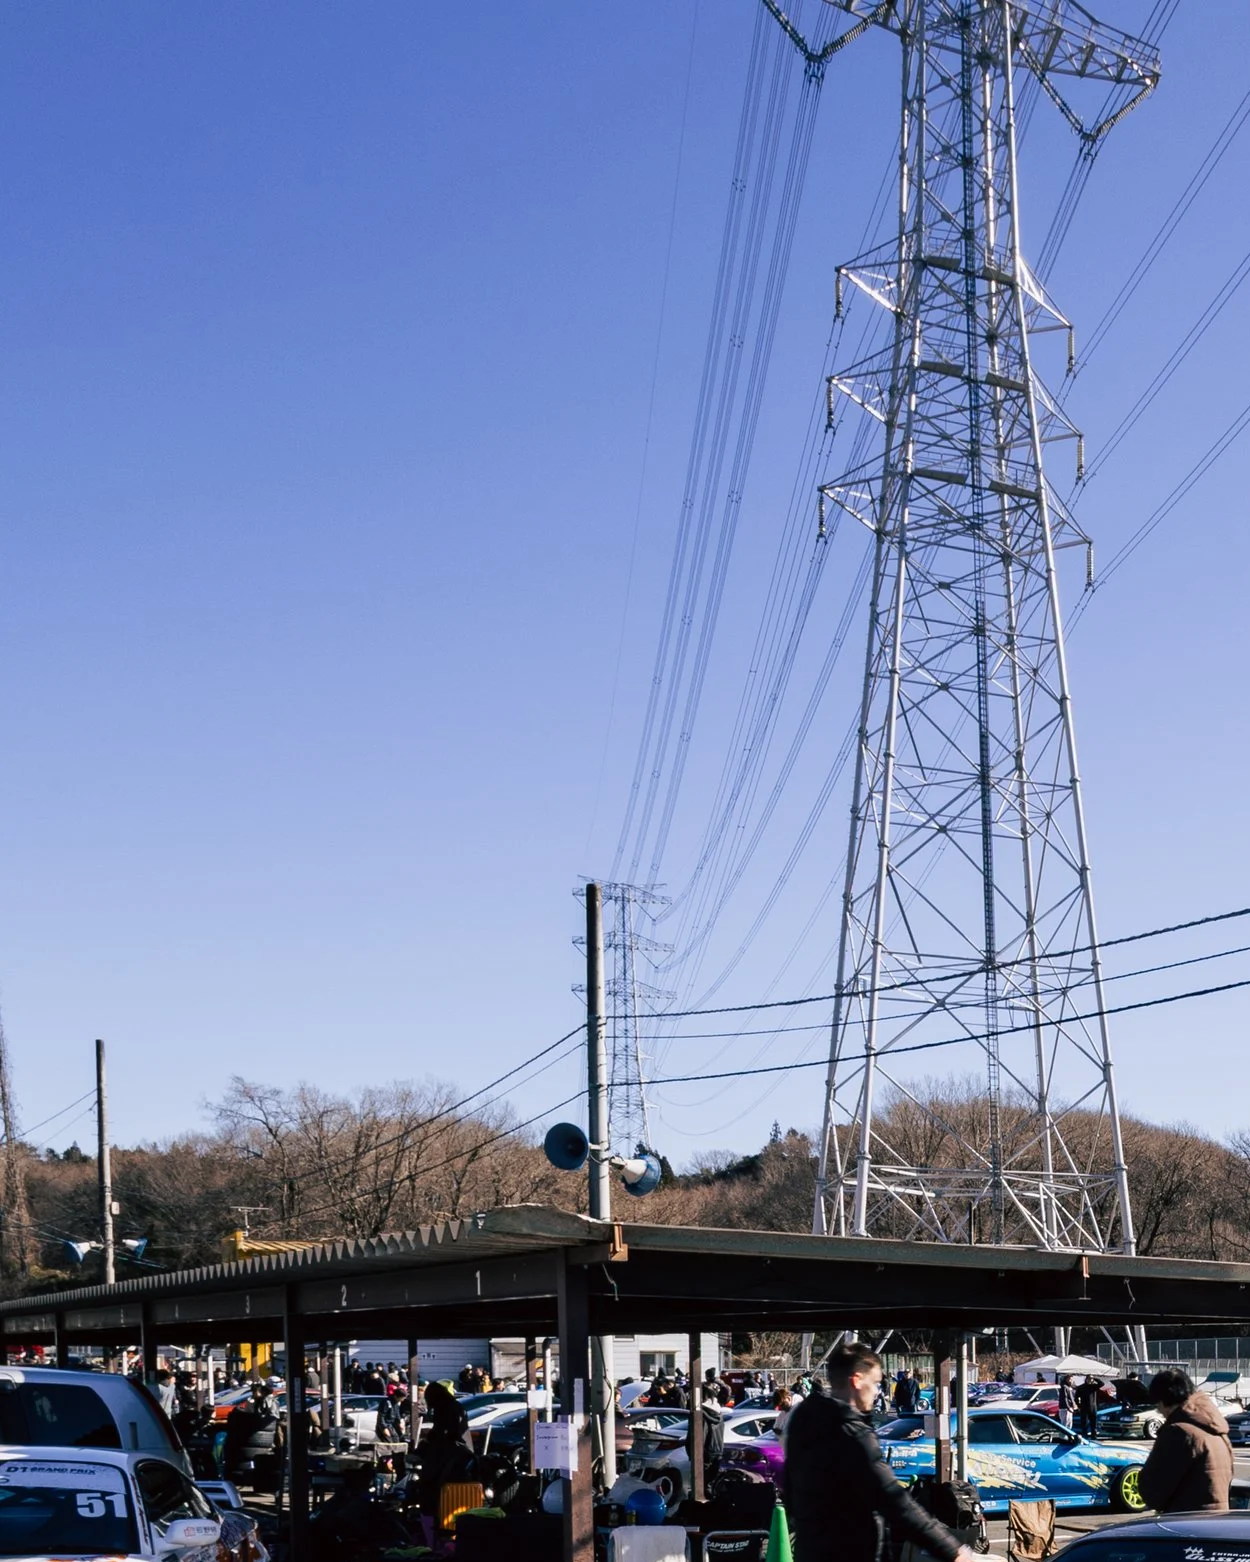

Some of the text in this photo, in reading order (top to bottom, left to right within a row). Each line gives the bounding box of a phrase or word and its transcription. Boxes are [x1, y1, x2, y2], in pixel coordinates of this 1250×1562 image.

[475, 1270, 482, 1296] 1
[341, 1284, 348, 1307] 2
[30, 1466, 68, 1474] GRAND
[76, 1493, 128, 1518] 51
[1185, 1553, 1234, 1562] GLASS
